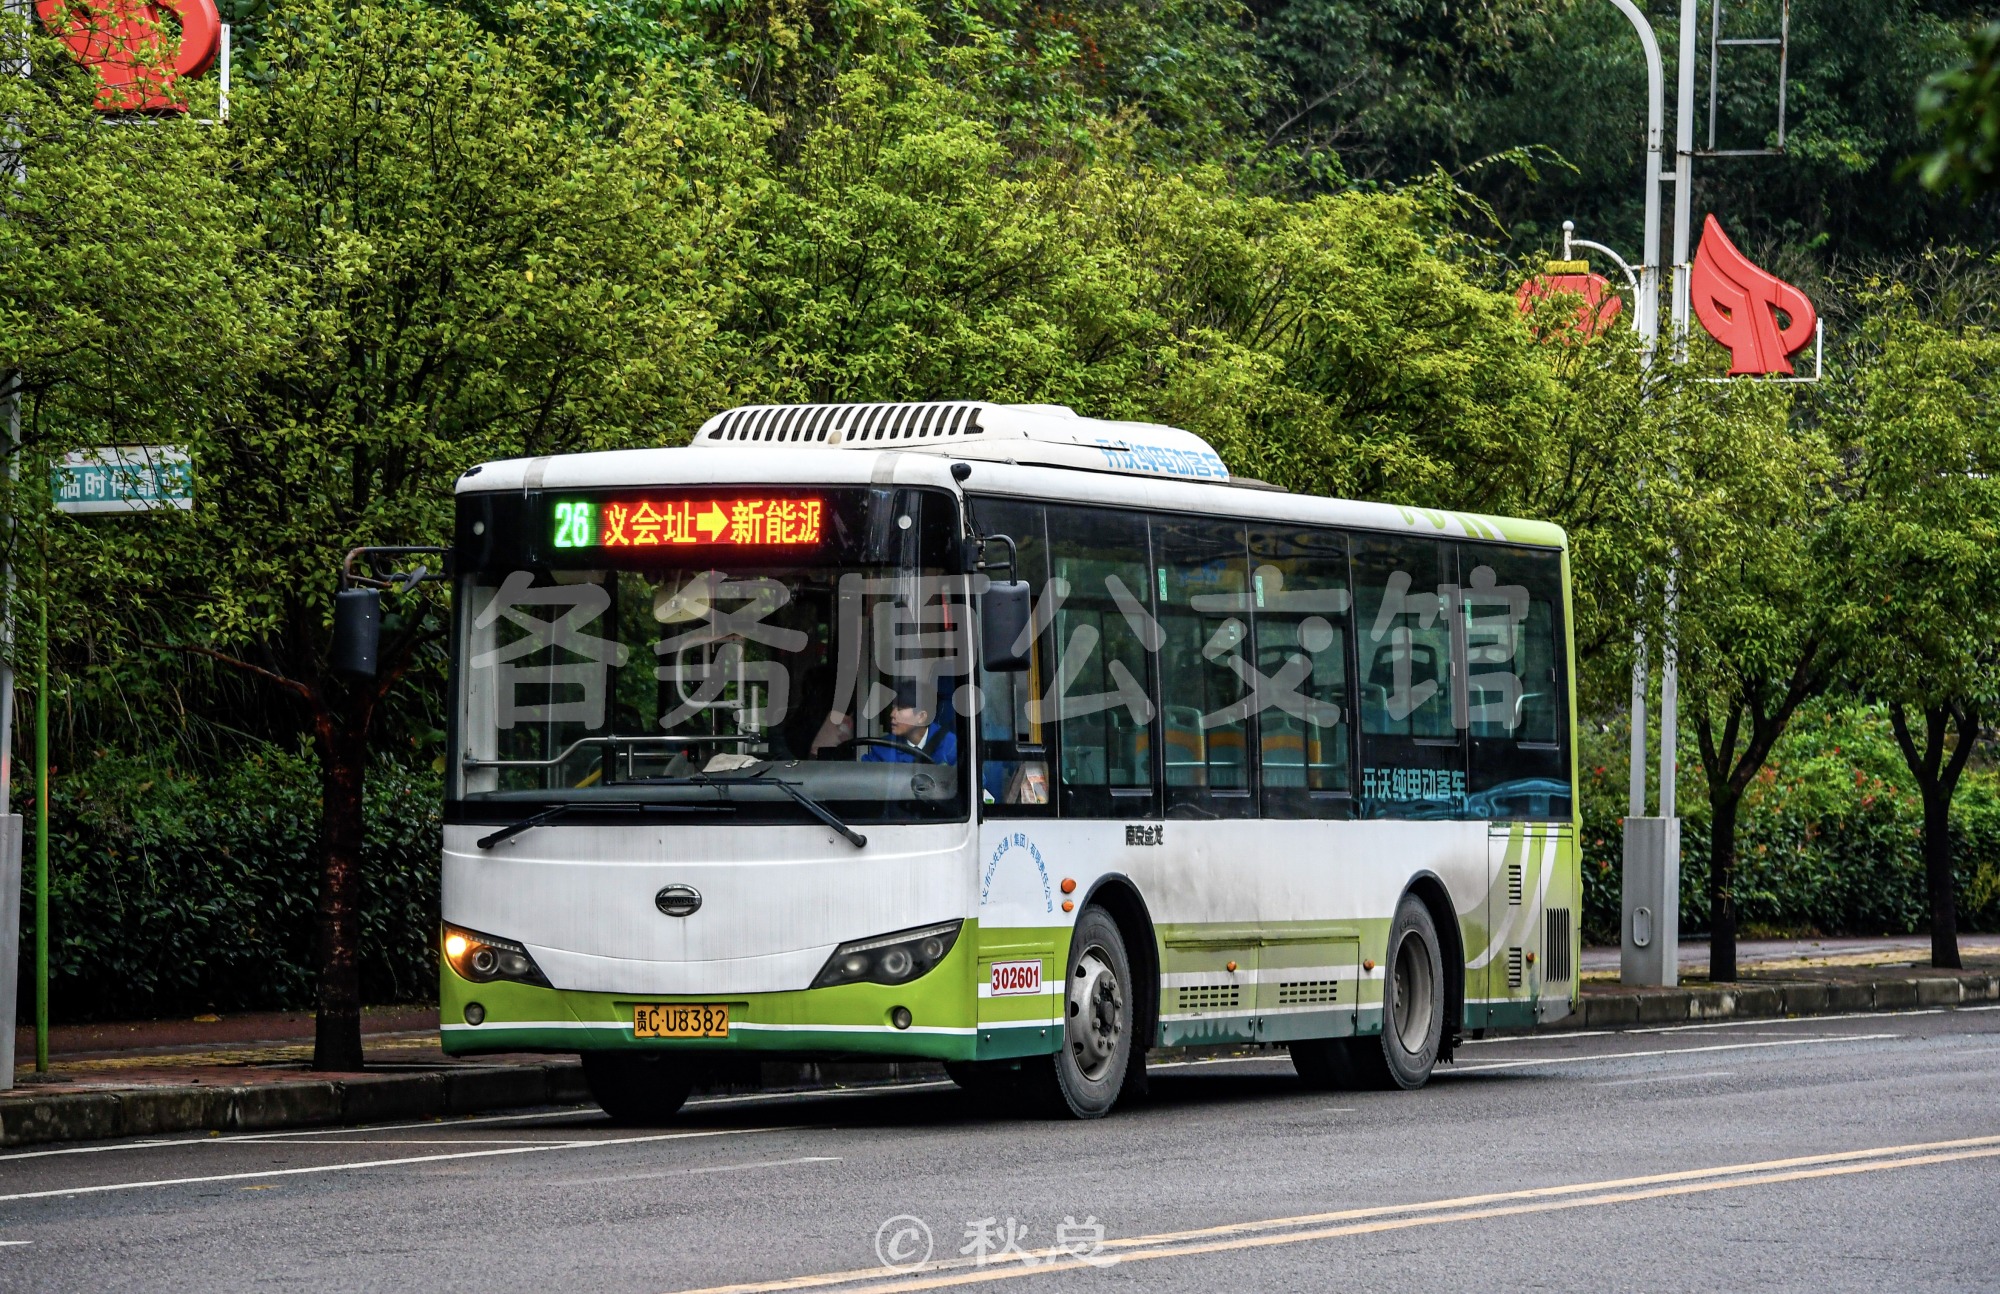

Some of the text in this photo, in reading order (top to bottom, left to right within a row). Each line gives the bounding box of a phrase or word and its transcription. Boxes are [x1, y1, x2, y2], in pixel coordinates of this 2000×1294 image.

[59, 469, 184, 499] 临时停靠站
[554, 502, 590, 547] 26
[1363, 768, 1466, 799] 开沃纯电动客车
[1125, 824, 1164, 846] 南京金龙
[992, 965, 1039, 990] 302601
